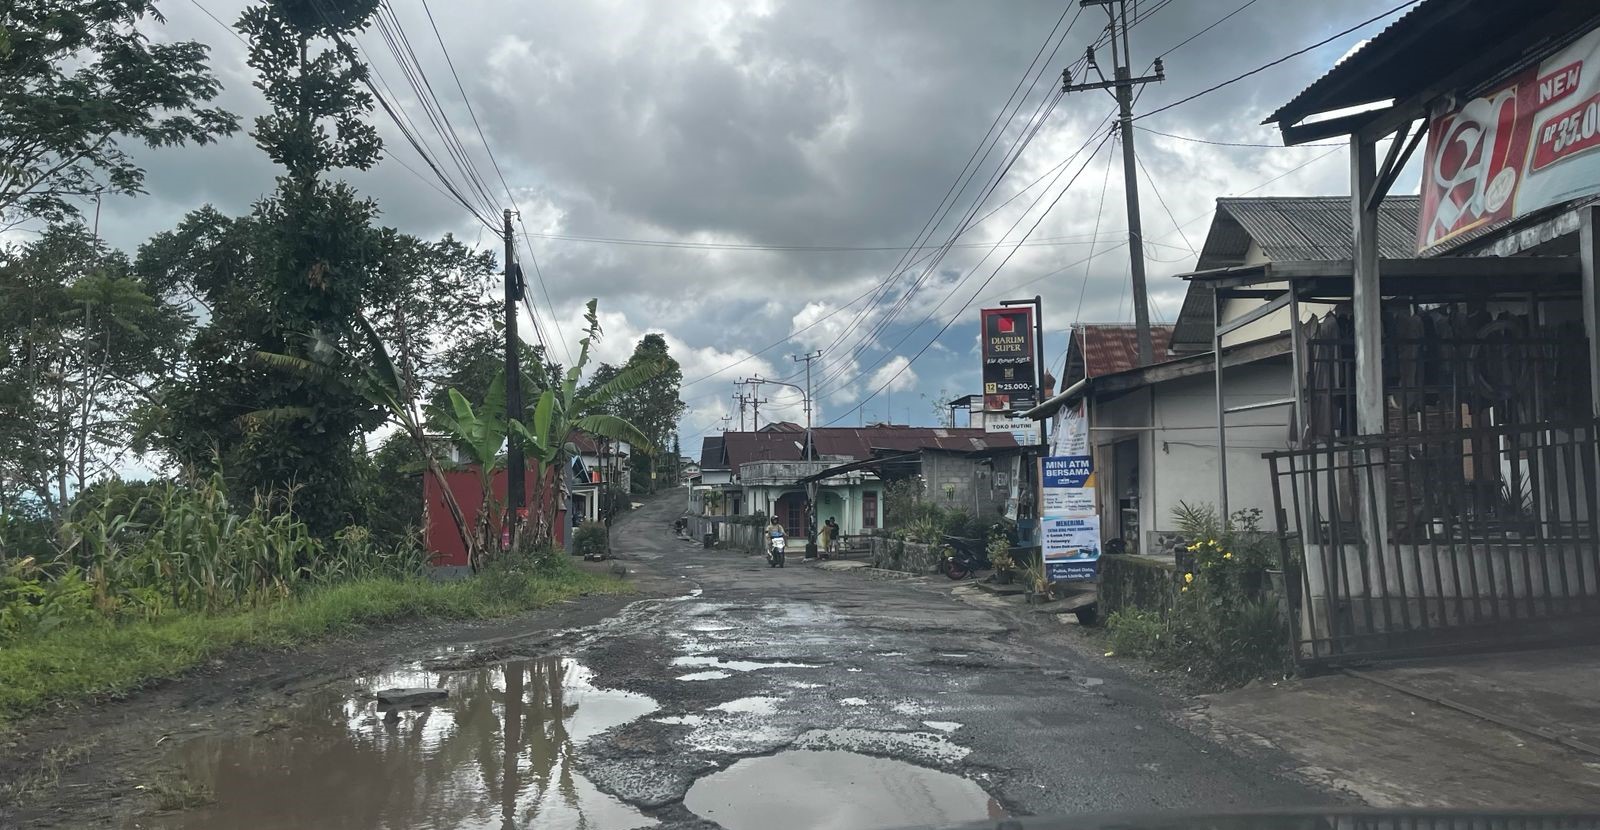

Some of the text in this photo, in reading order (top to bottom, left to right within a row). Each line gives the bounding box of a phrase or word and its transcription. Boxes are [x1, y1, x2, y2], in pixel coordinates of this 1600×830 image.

[1539, 66, 1580, 104] NEW
[1543, 102, 1600, 153] RP 35.0
[994, 344, 1021, 352] SUPER
[1046, 460, 1089, 469] MINI ATM
[1046, 468, 1090, 477] BERSAMA
